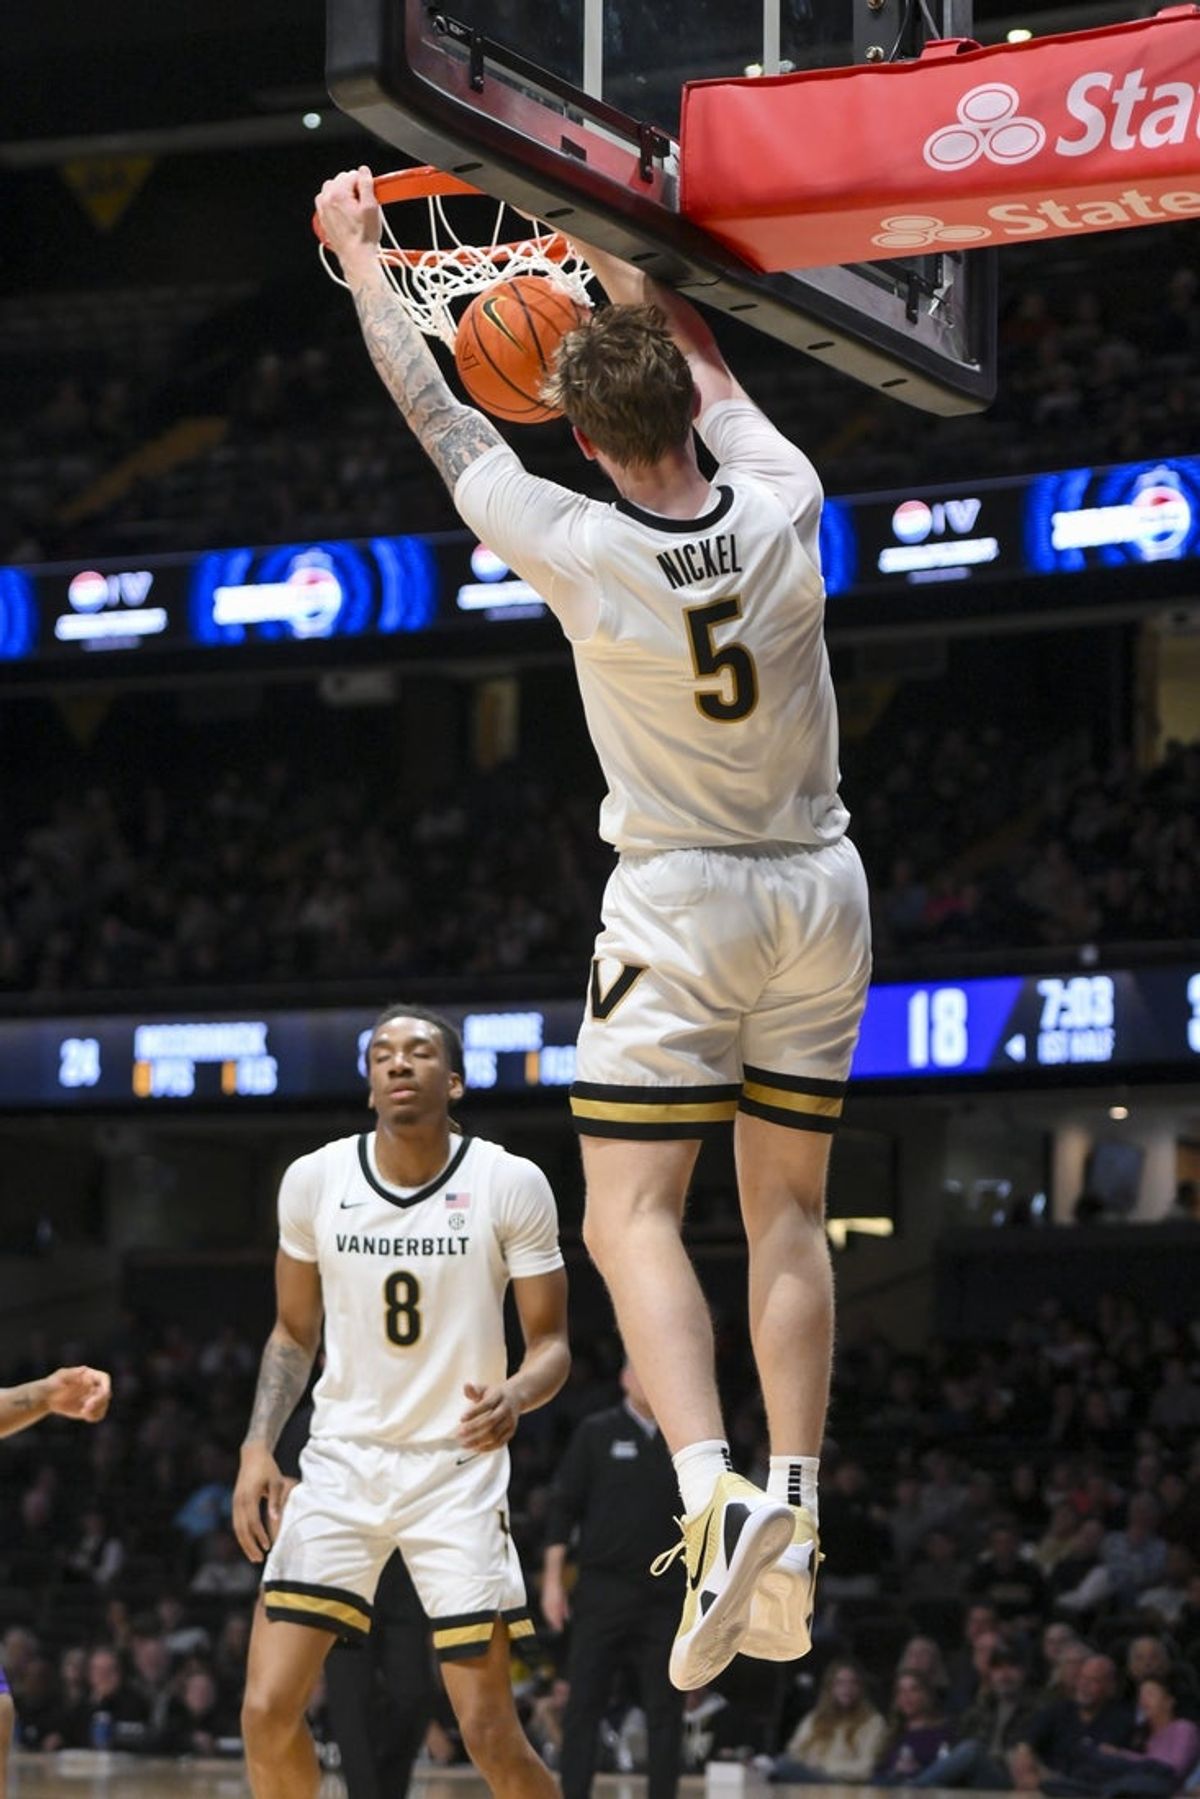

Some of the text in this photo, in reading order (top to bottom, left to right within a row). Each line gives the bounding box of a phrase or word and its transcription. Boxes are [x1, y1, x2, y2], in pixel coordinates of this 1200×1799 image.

[1055, 68, 1200, 157] Sta
[987, 188, 1200, 235] State
[656, 534, 742, 590] NICKEL
[682, 592, 759, 724] 5
[591, 957, 650, 1022] V
[908, 988, 968, 1068] 18
[335, 1234, 470, 1256] VANDERBILT
[383, 1269, 422, 1347] 8
